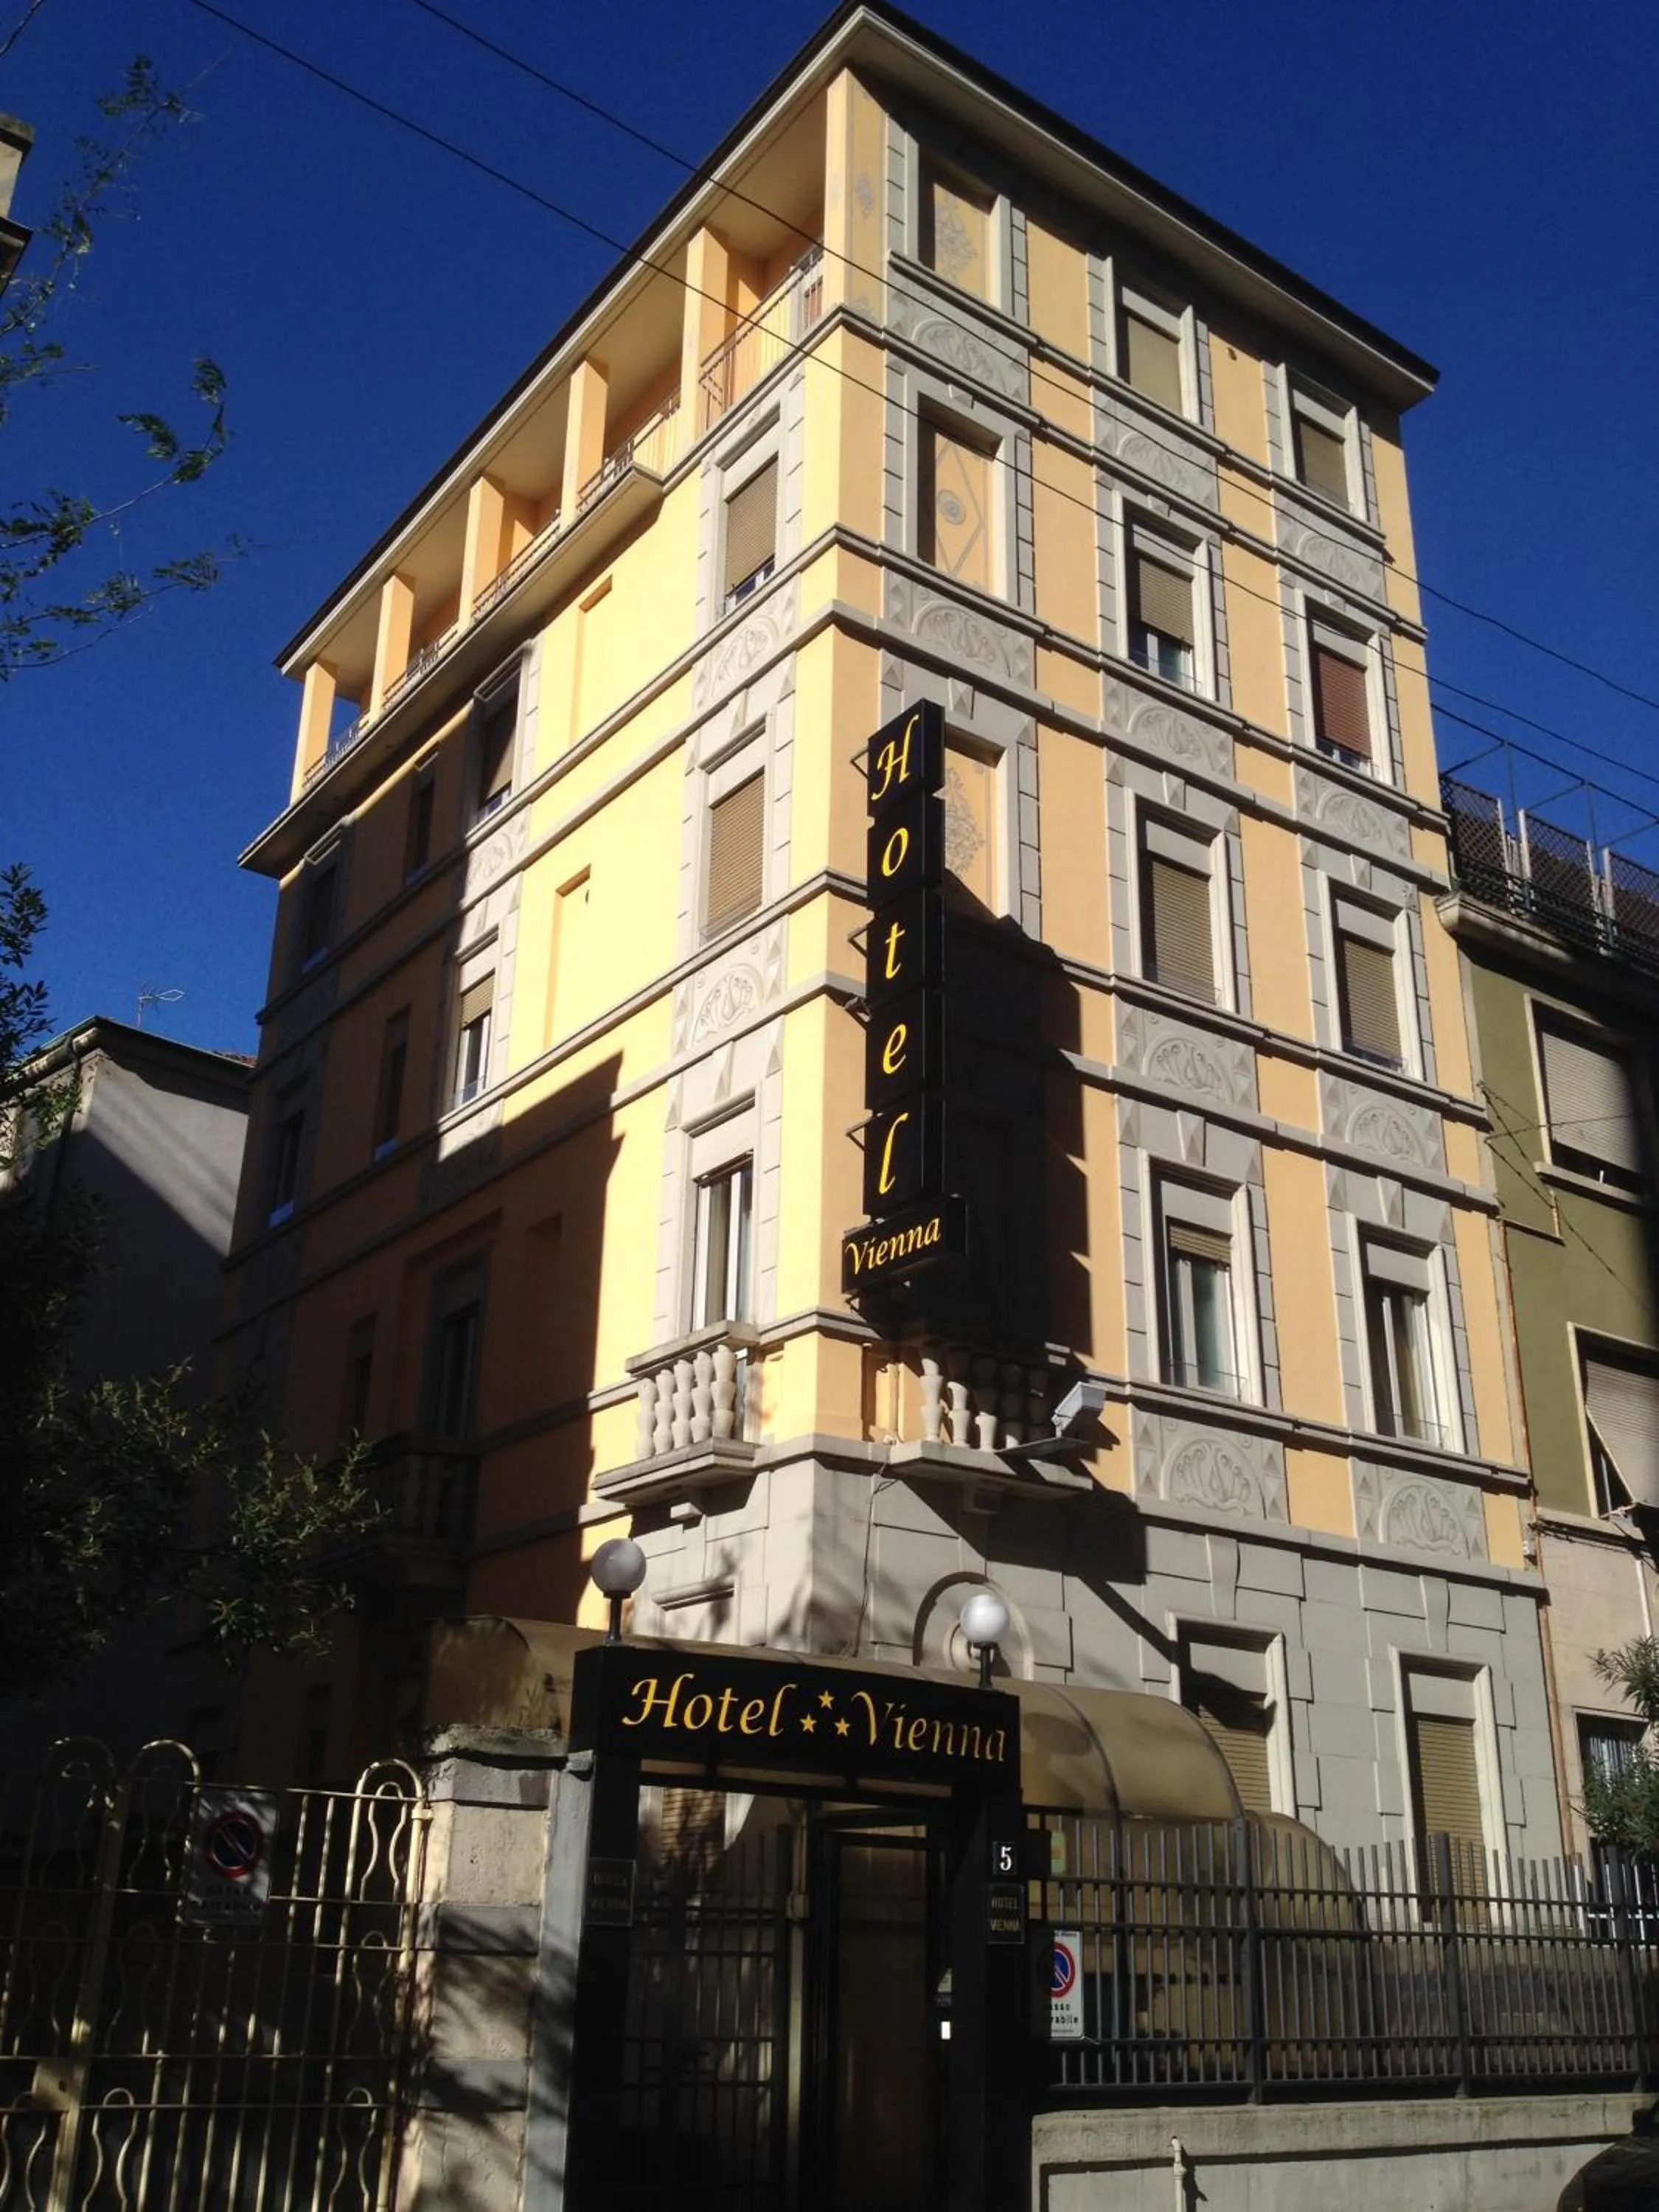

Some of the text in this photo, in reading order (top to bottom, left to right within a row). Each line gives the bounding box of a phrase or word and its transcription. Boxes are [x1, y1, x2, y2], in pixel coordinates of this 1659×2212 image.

[871, 714, 919, 1195] Hotel
[844, 1217, 942, 1276] Vienna
[622, 1672, 1006, 1762] Hotel Vienna
[999, 1845, 1013, 1871] 5
[991, 1896, 1018, 1910] HOTEL
[990, 1919, 1020, 1932] VIENNA
